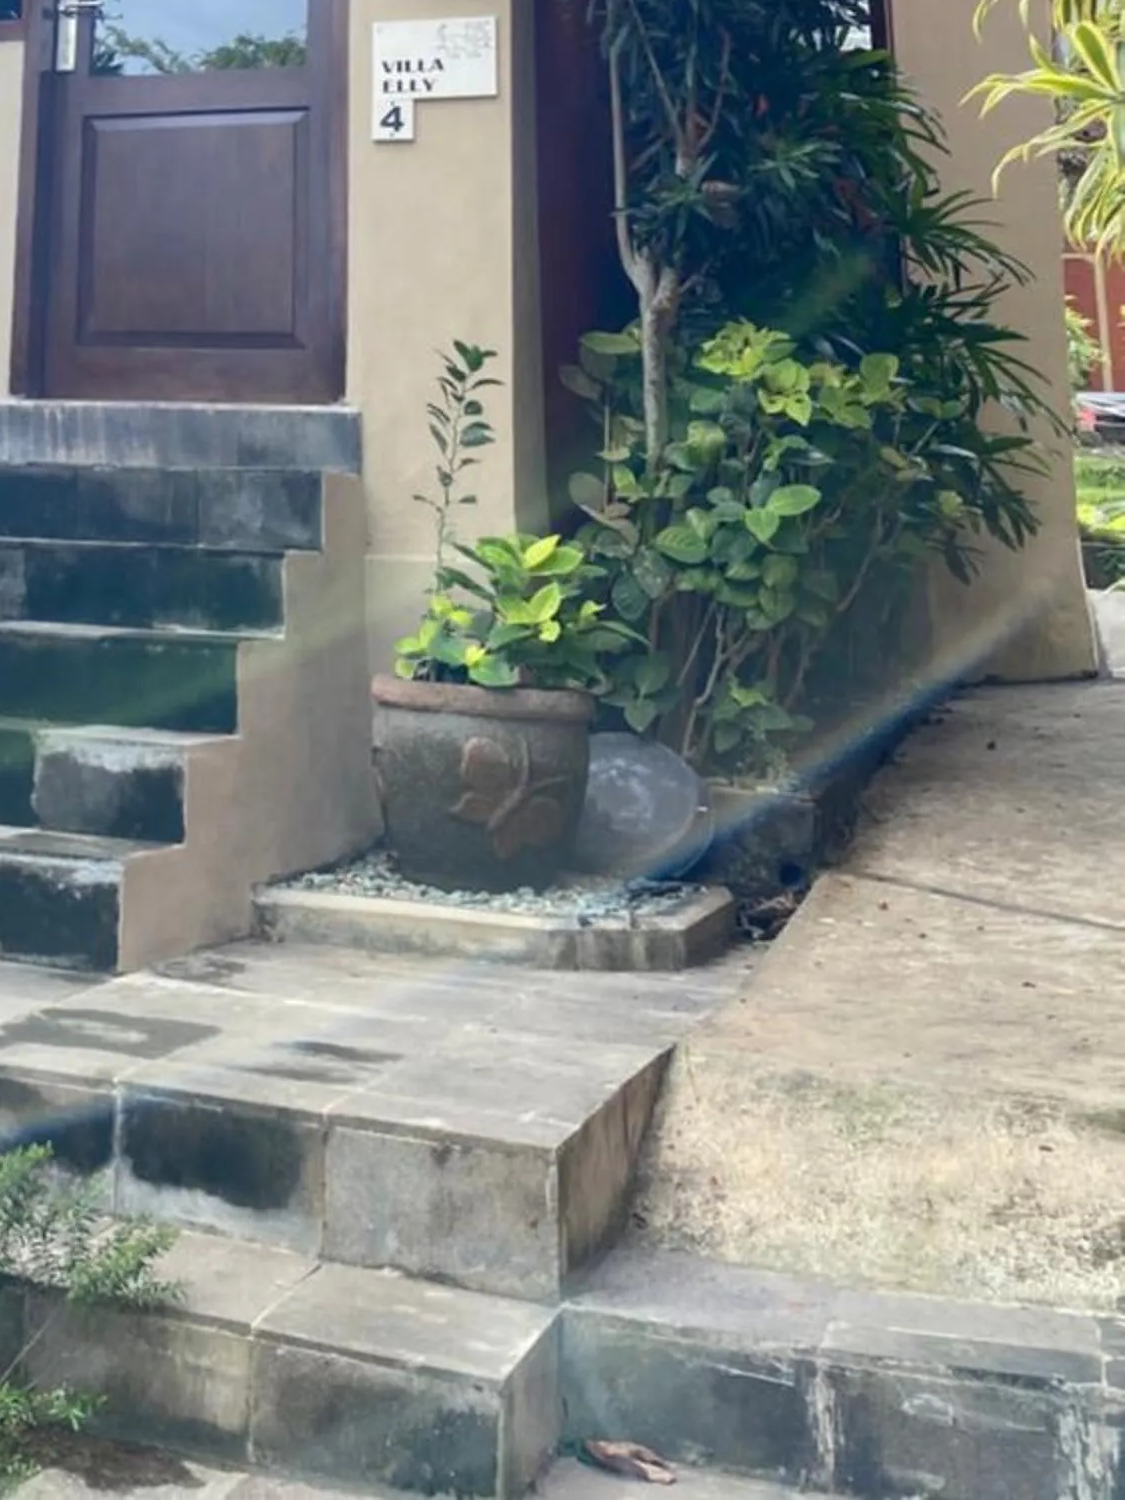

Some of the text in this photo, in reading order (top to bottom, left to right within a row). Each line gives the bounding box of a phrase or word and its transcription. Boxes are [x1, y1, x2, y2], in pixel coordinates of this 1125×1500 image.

[382, 58, 444, 73] VILLA
[383, 78, 436, 94] ELLY
[380, 106, 404, 132] 4
